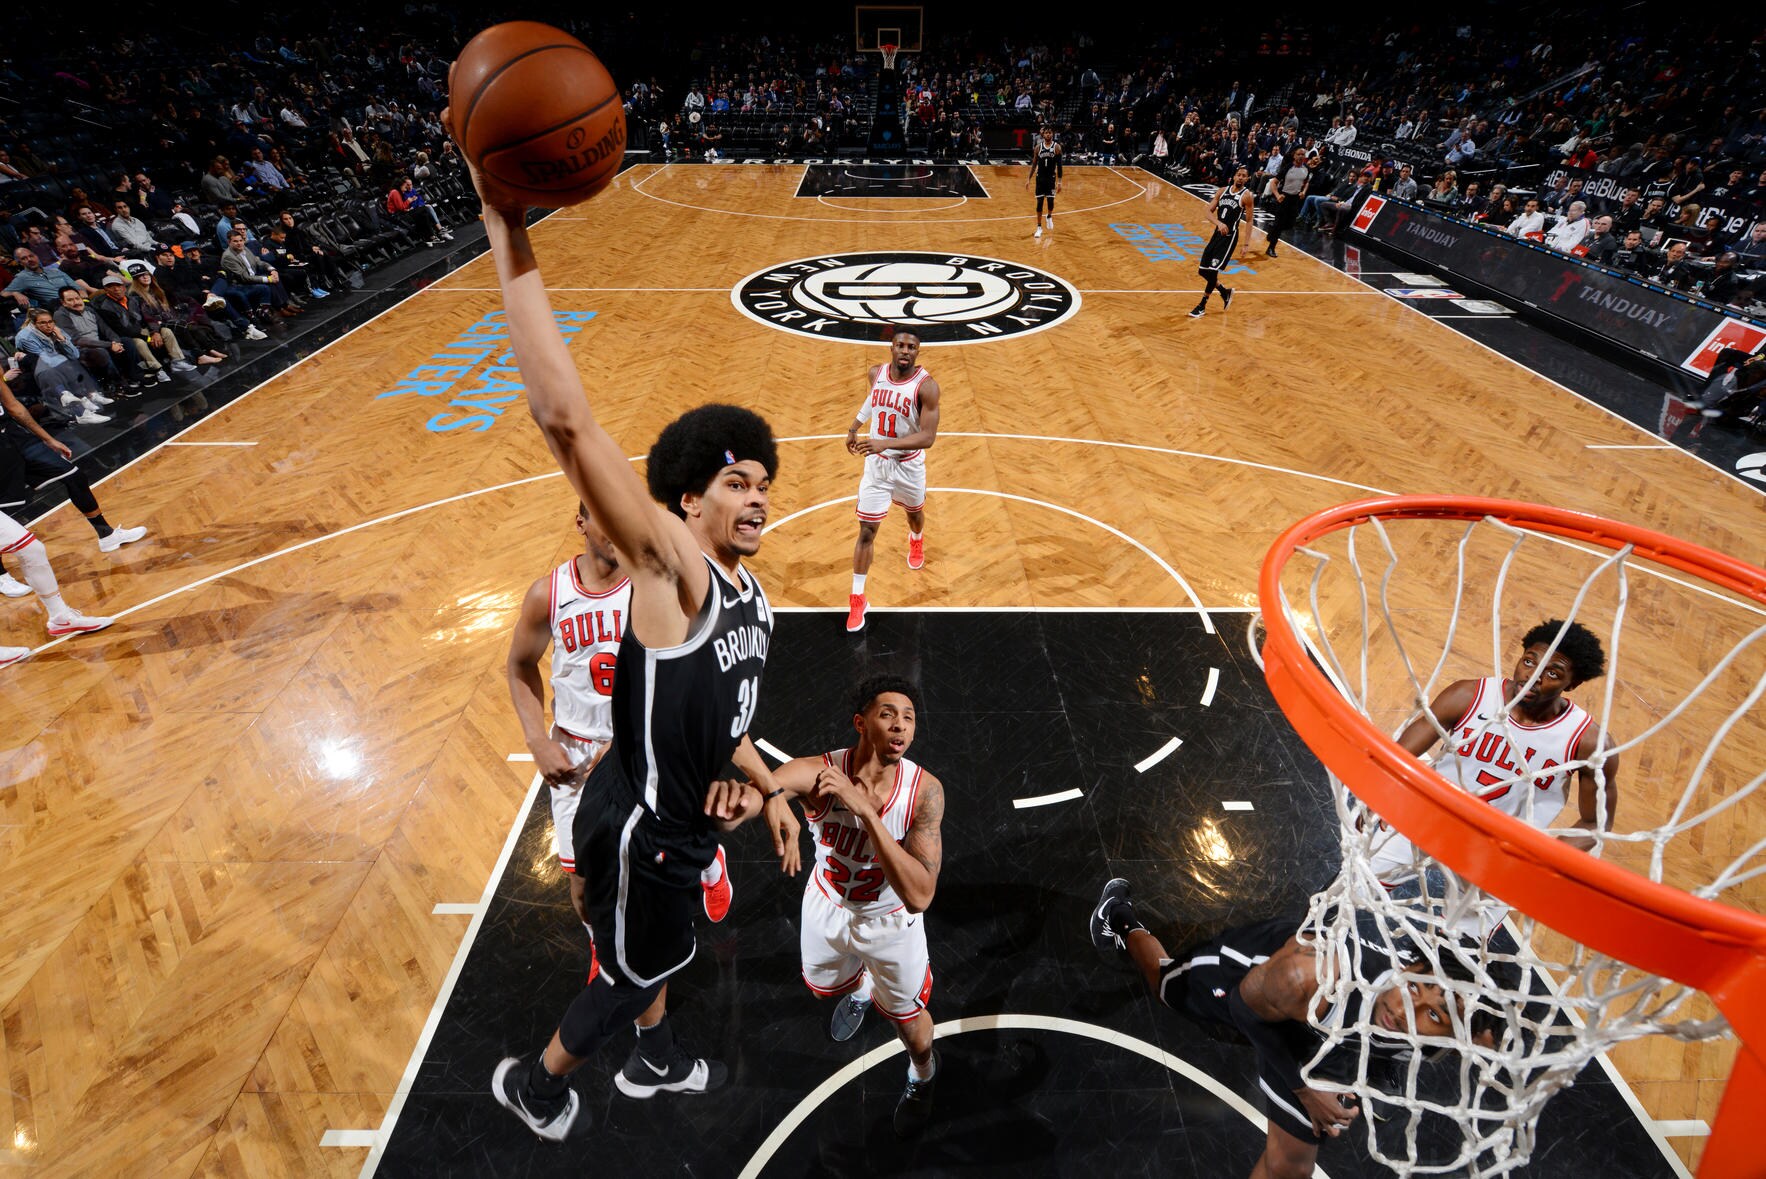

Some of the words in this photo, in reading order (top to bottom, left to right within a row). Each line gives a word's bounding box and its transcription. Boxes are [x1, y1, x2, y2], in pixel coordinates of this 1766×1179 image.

[520, 116, 624, 185] SPALDING
[1344, 148, 1372, 162] HONDA
[1582, 175, 1628, 202] jetBlue
[1361, 207, 1376, 219] infor
[1405, 221, 1460, 248] TANDUAY
[763, 258, 846, 284] NEW
[749, 290, 840, 332] YORK
[946, 257, 1063, 336] BROOKLYN
[1578, 285, 1672, 328] TANDUAY
[1707, 337, 1736, 354] inf
[425, 310, 598, 432] BLAYS
[871, 389, 911, 417] BULLS
[877, 411, 898, 438] 11
[559, 610, 622, 653] BULL
[713, 625, 770, 673] BROKLY
[589, 652, 617, 696] 6
[730, 675, 758, 738] 31
[1476, 769, 1513, 804] 7
[820, 822, 882, 863] BUL
[823, 855, 885, 902] 22
